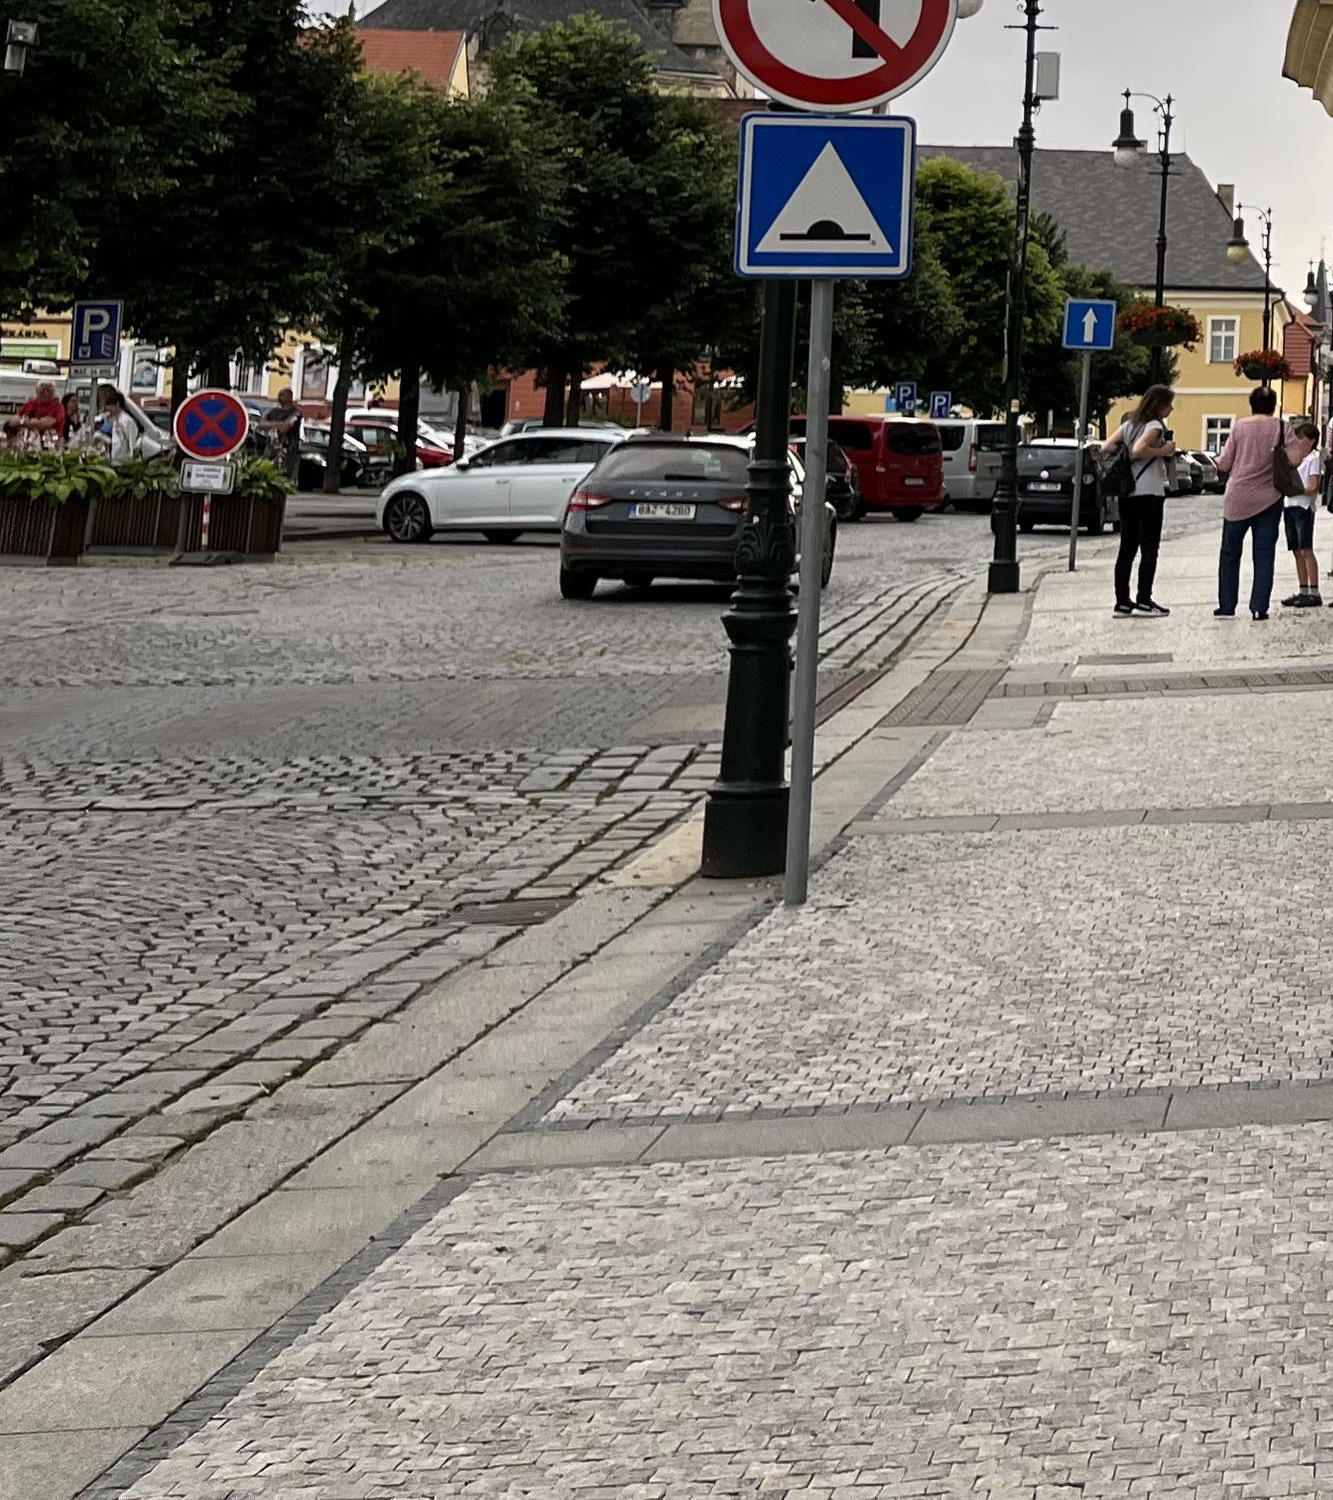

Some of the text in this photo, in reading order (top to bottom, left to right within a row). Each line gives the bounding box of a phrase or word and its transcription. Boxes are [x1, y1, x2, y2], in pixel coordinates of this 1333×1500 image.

[82, 308, 111, 344] P
[900, 385, 912, 404] P
[934, 394, 947, 414] P
